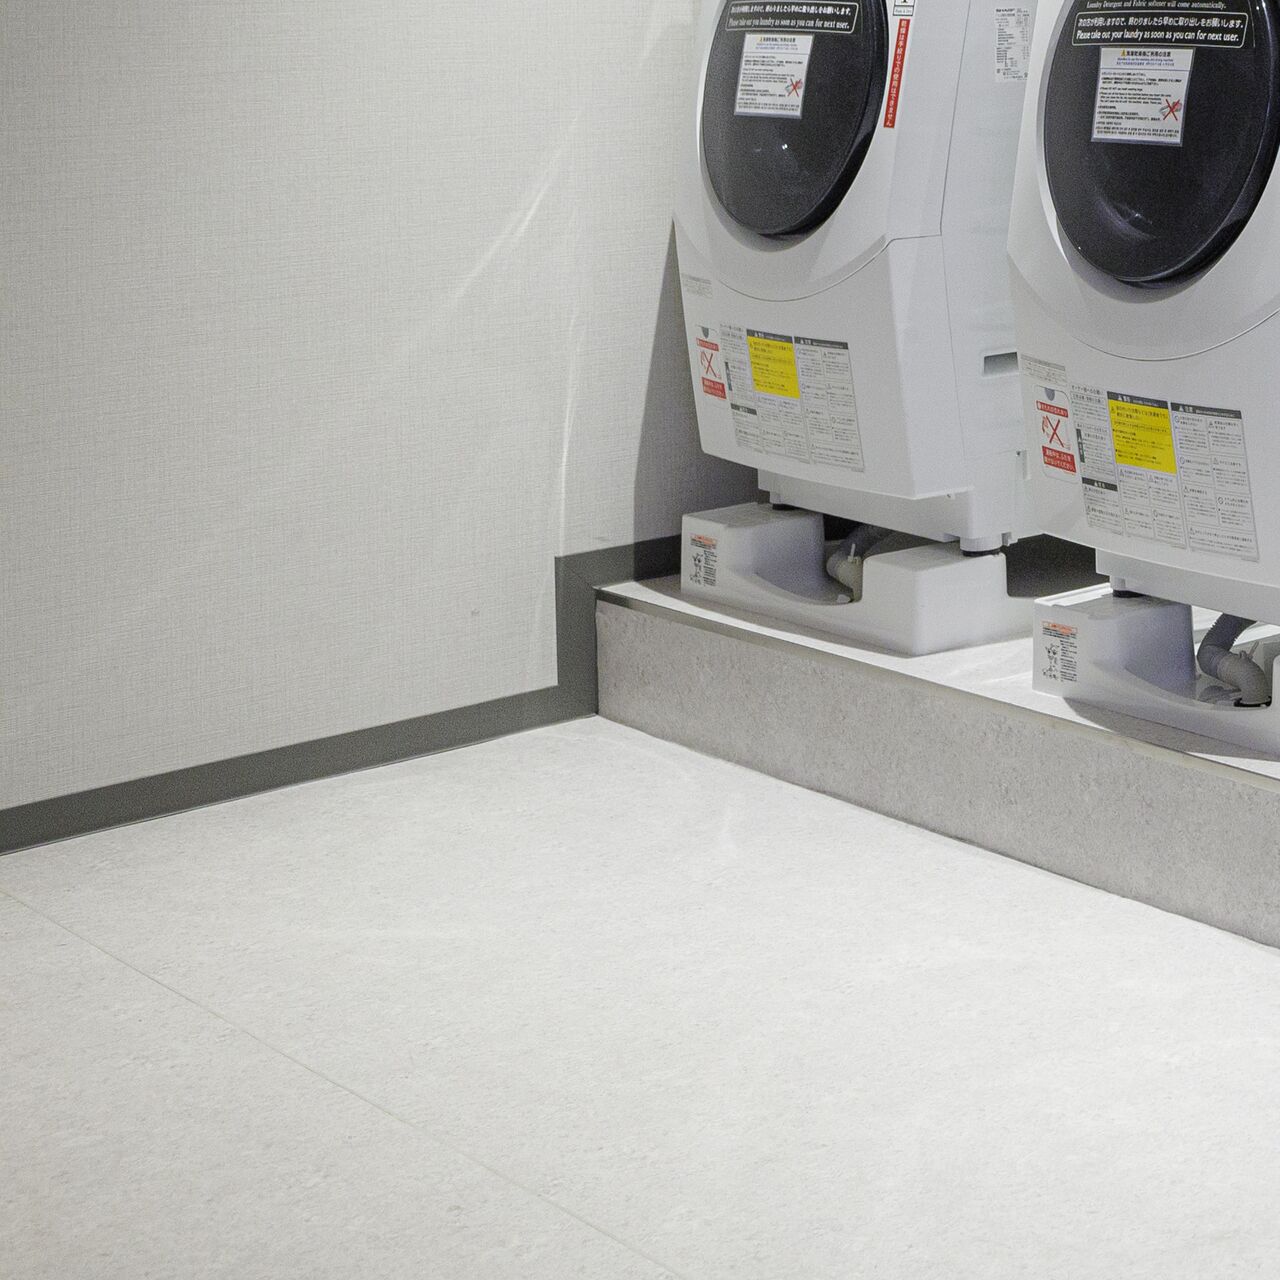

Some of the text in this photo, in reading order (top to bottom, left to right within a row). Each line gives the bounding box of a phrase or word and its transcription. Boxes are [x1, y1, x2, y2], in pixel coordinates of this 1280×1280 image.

[1111, 31, 1123, 41] your
[1124, 29, 1143, 41] laundry
[1151, 31, 1164, 39] soon
[1172, 32, 1183, 42] you
[1197, 30, 1207, 39] for
[1208, 32, 1222, 40] next
